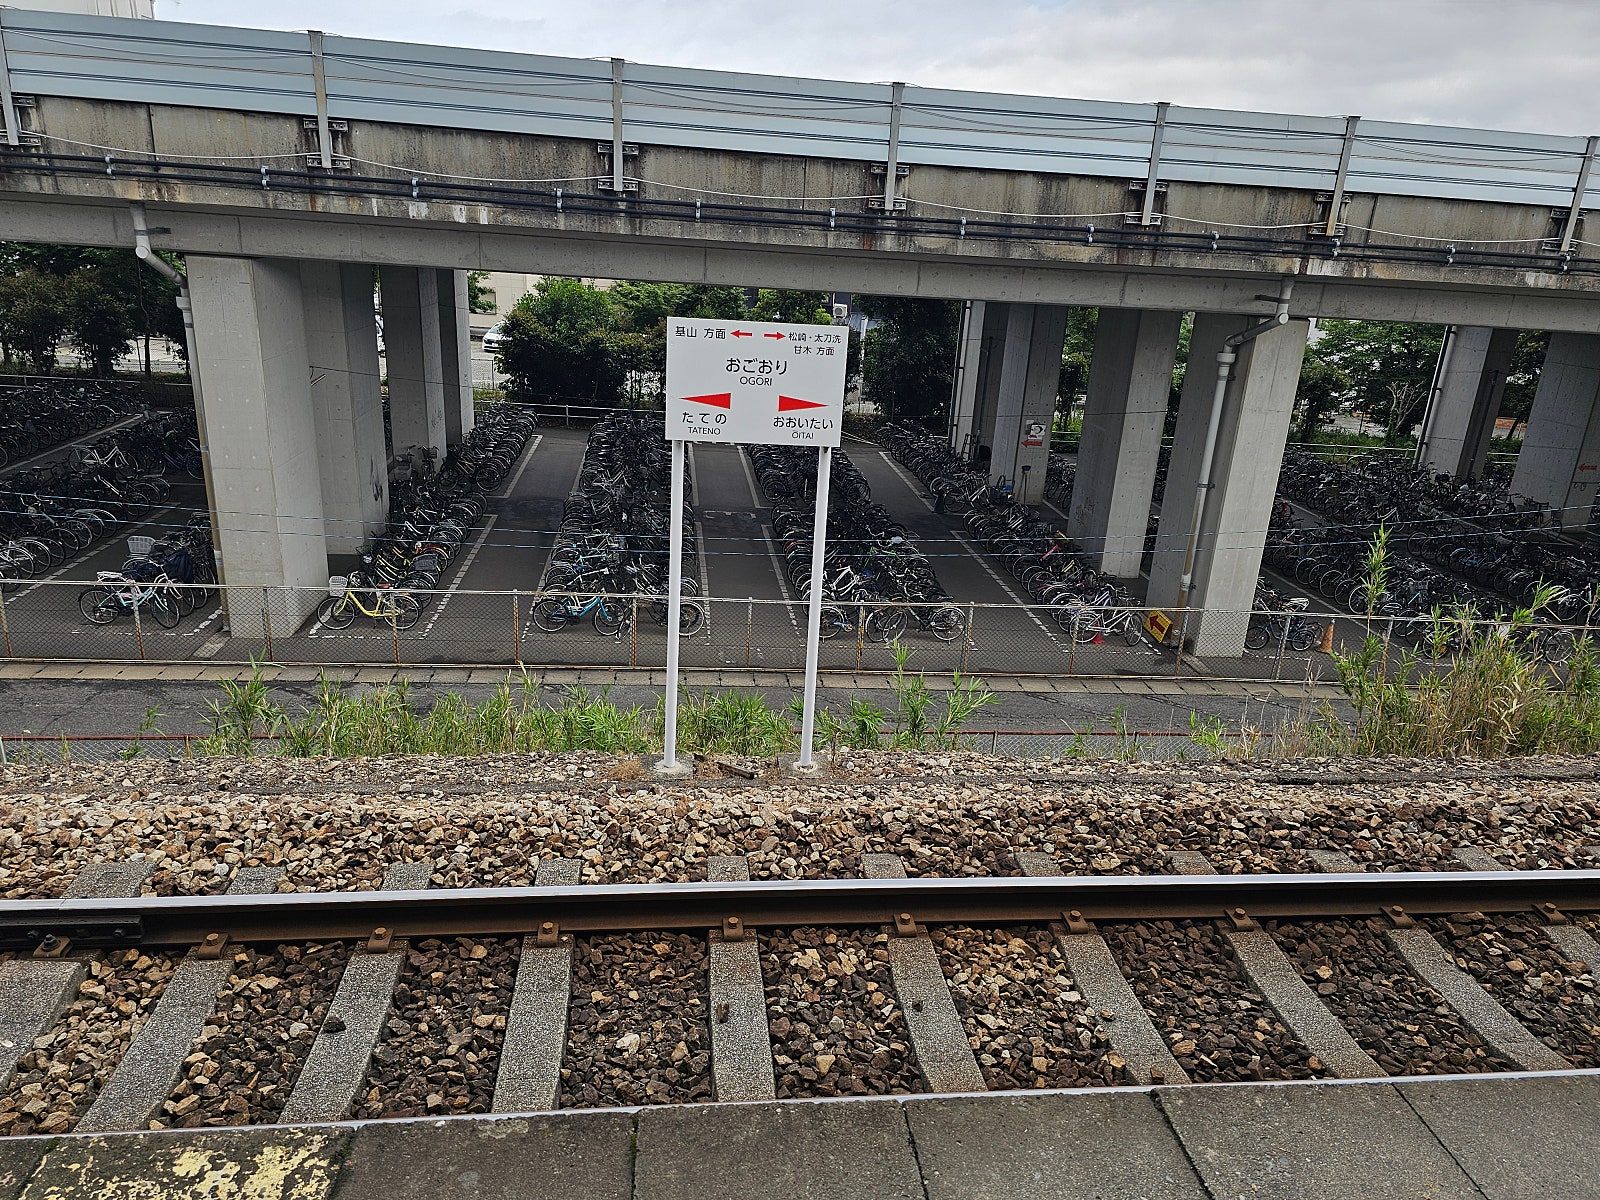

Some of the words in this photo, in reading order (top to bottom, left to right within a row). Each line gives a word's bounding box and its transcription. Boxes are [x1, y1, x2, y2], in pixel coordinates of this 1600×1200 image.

[675, 325, 698, 338] 基山
[703, 327, 727, 340] 方面
[793, 345, 813, 355] 甘木
[816, 346, 835, 356] 方面
[725, 357, 788, 376] おごおり
[739, 375, 773, 387] OGŌRI
[681, 411, 728, 425] たての
[773, 416, 834, 430] おおいたい
[687, 426, 721, 436] TATENO
[791, 429, 815, 440] ŌITAI
